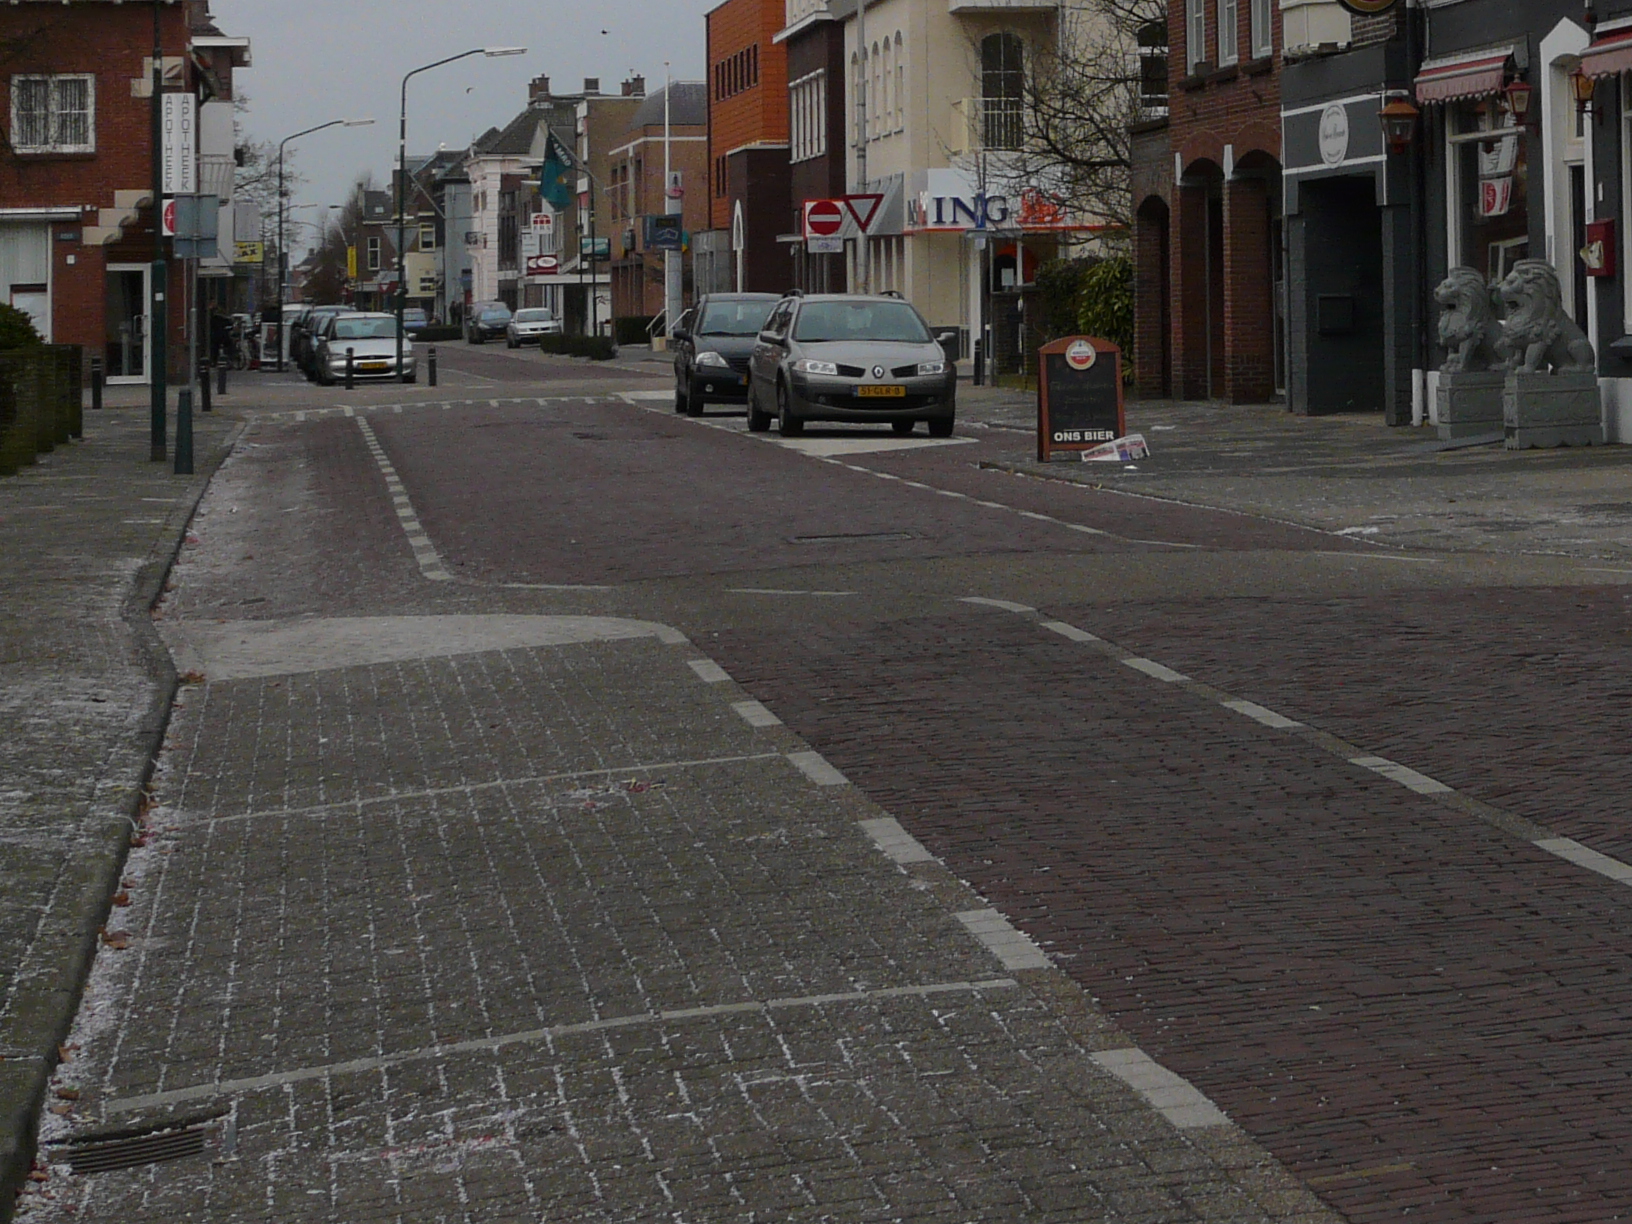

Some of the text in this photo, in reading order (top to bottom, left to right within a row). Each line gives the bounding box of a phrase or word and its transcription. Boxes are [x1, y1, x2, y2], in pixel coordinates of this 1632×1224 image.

[165, 95, 173, 191] APOTHEEK
[181, 95, 190, 191] APOTHEEK
[932, 196, 1009, 224] ING
[1053, 430, 1114, 442] ONS BIER
